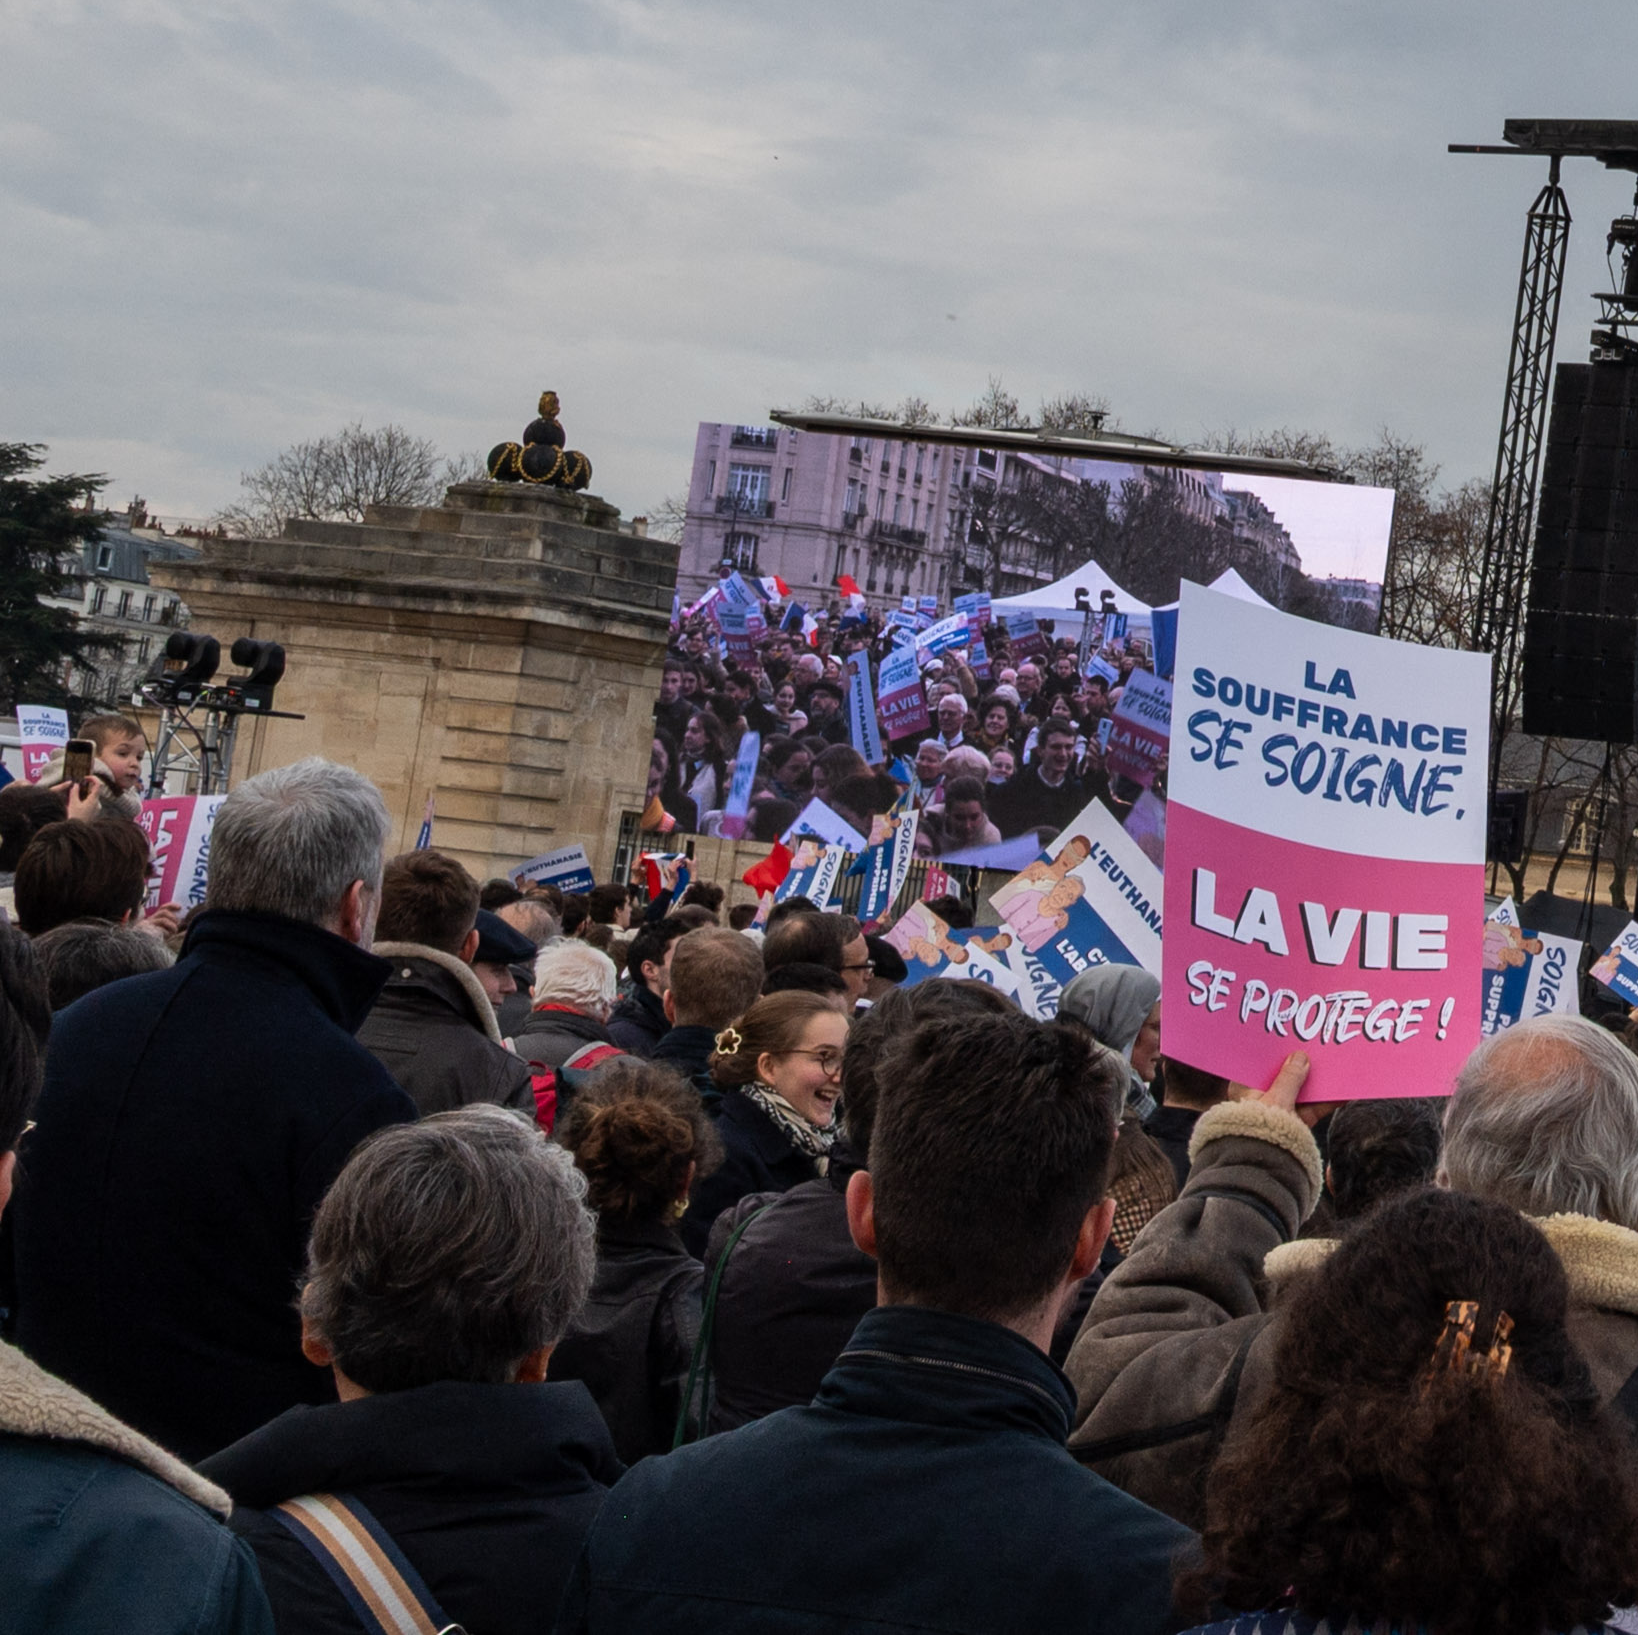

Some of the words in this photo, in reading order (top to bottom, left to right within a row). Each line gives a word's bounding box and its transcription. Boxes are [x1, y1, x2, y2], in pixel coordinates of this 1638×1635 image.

[881, 704, 898, 718] LA
[897, 693, 921, 708] VIE
[1303, 660, 1357, 700] LA
[1187, 709, 1253, 771] SE
[1191, 667, 1469, 756] SOUFFRANCE
[1134, 737, 1162, 759] VIE
[154, 809, 179, 853] LA
[879, 868, 889, 892] PAS
[1090, 841, 1163, 940] L'EUTHANA
[1191, 866, 1291, 957] LA
[1299, 900, 1450, 971] VIE
[1186, 960, 1237, 1013] SE
[1435, 996, 1457, 1041] !
[1482, 974, 1505, 1036] SUPPR
